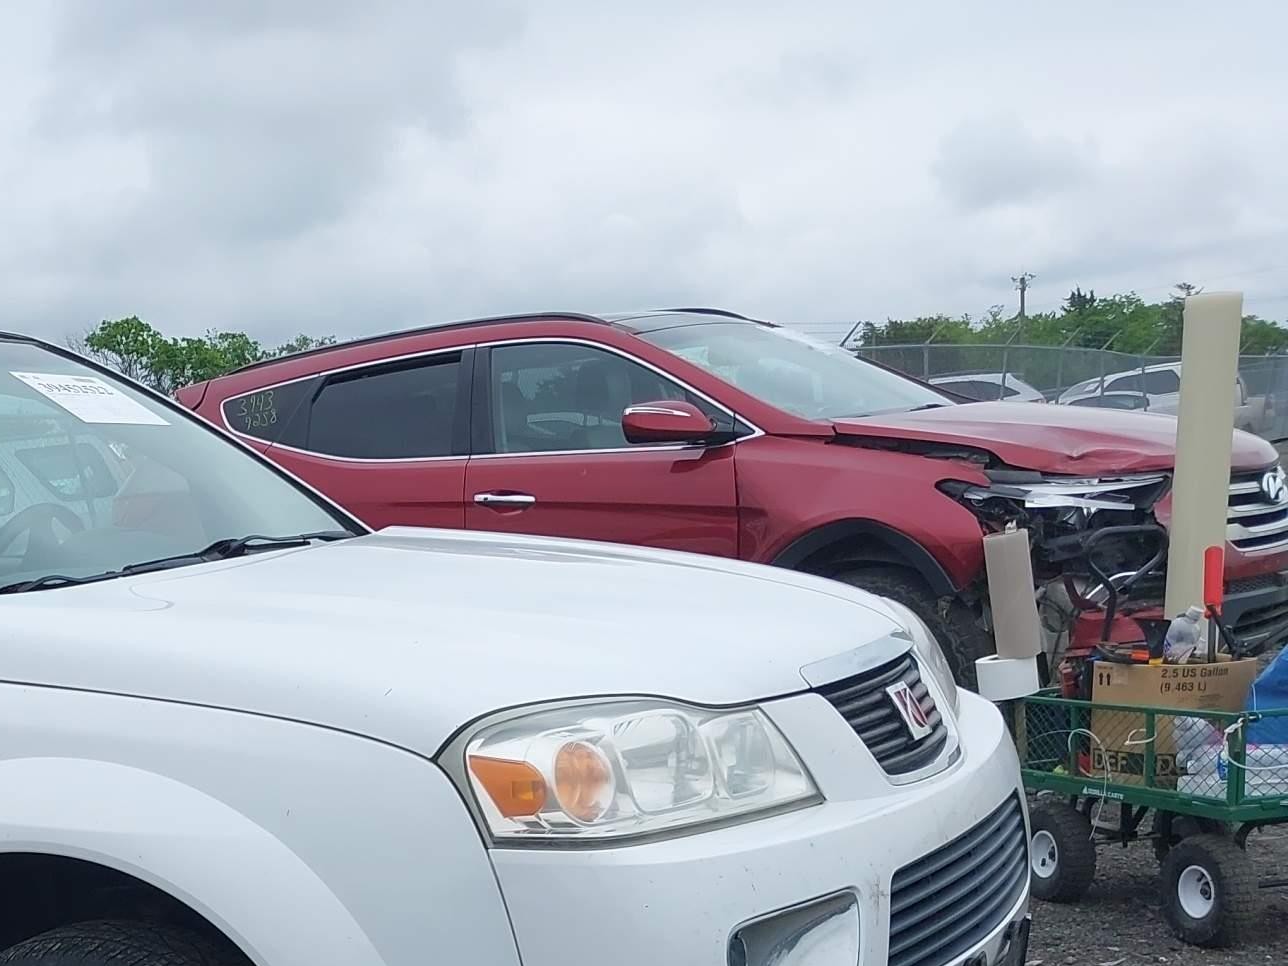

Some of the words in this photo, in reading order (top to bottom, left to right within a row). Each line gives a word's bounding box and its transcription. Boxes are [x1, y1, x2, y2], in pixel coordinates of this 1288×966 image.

[244, 409, 278, 430] 9258
[1161, 668, 1179, 679] 2.5
[1182, 667, 1197, 679] US
[1200, 666, 1229, 679] Gallon
[1197, 681, 1207, 693] L)
